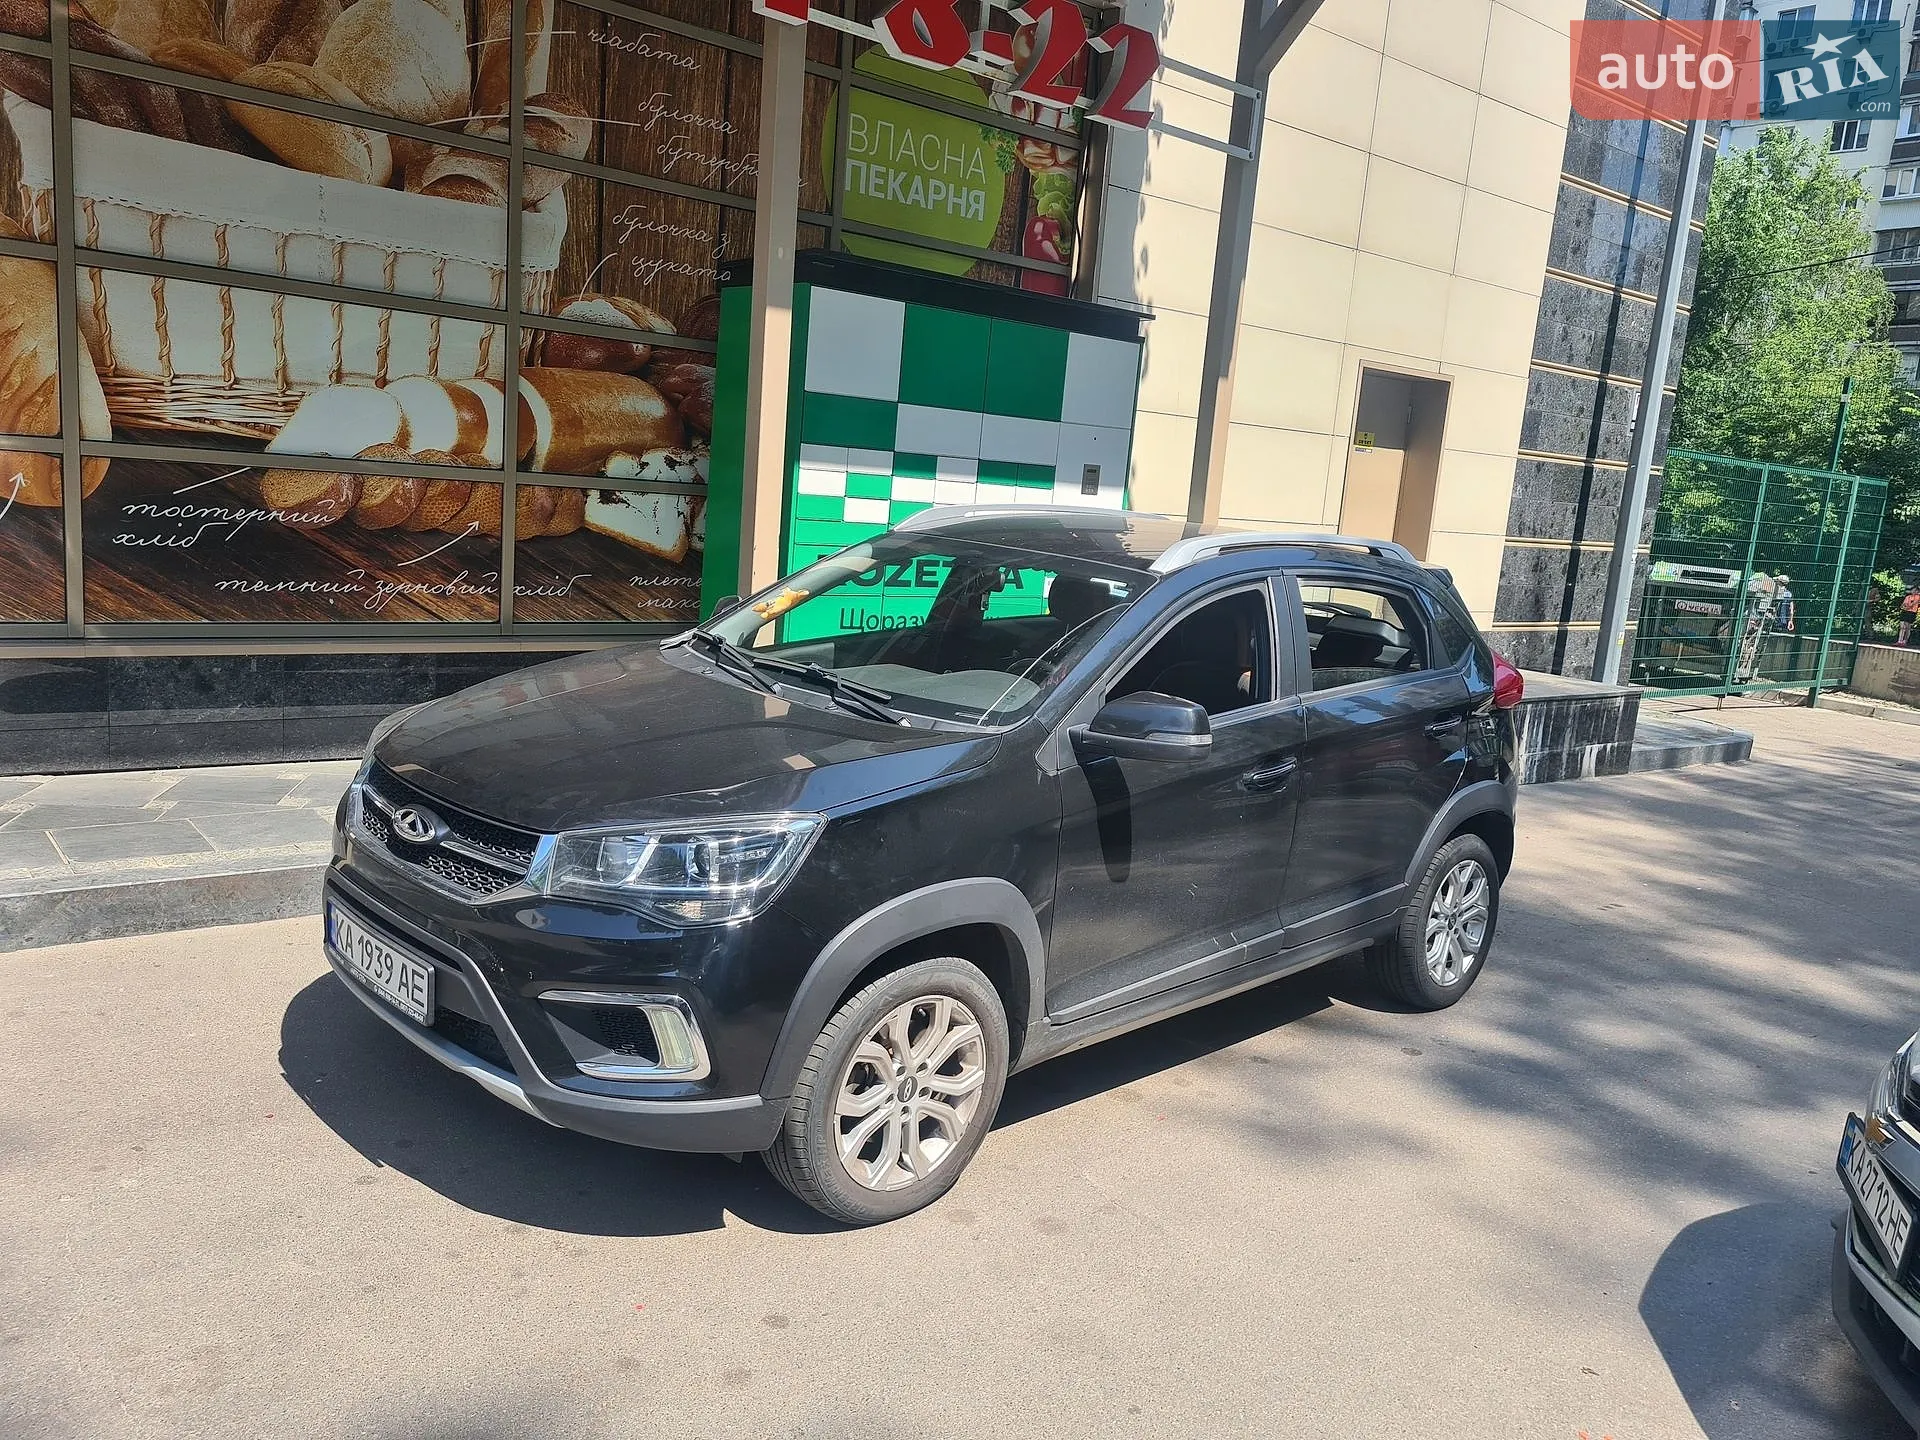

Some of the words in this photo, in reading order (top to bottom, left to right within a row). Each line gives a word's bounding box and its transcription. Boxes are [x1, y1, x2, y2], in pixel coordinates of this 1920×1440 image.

[638, 92, 738, 131] булочка
[657, 135, 760, 189] бутербр
[848, 113, 986, 184] ВЛАСНА
[845, 160, 986, 222] ПЕКАРНЯ
[612, 204, 713, 244] булочка
[711, 233, 731, 259] з
[112, 522, 229, 548] хліб
[122, 499, 338, 541] тостерний
[215, 568, 365, 593] темний
[364, 570, 498, 612] зерновий
[512, 574, 592, 597] хліб
[336, 914, 354, 959] KA
[357, 934, 394, 985] 1939
[398, 962, 425, 1008] AE
